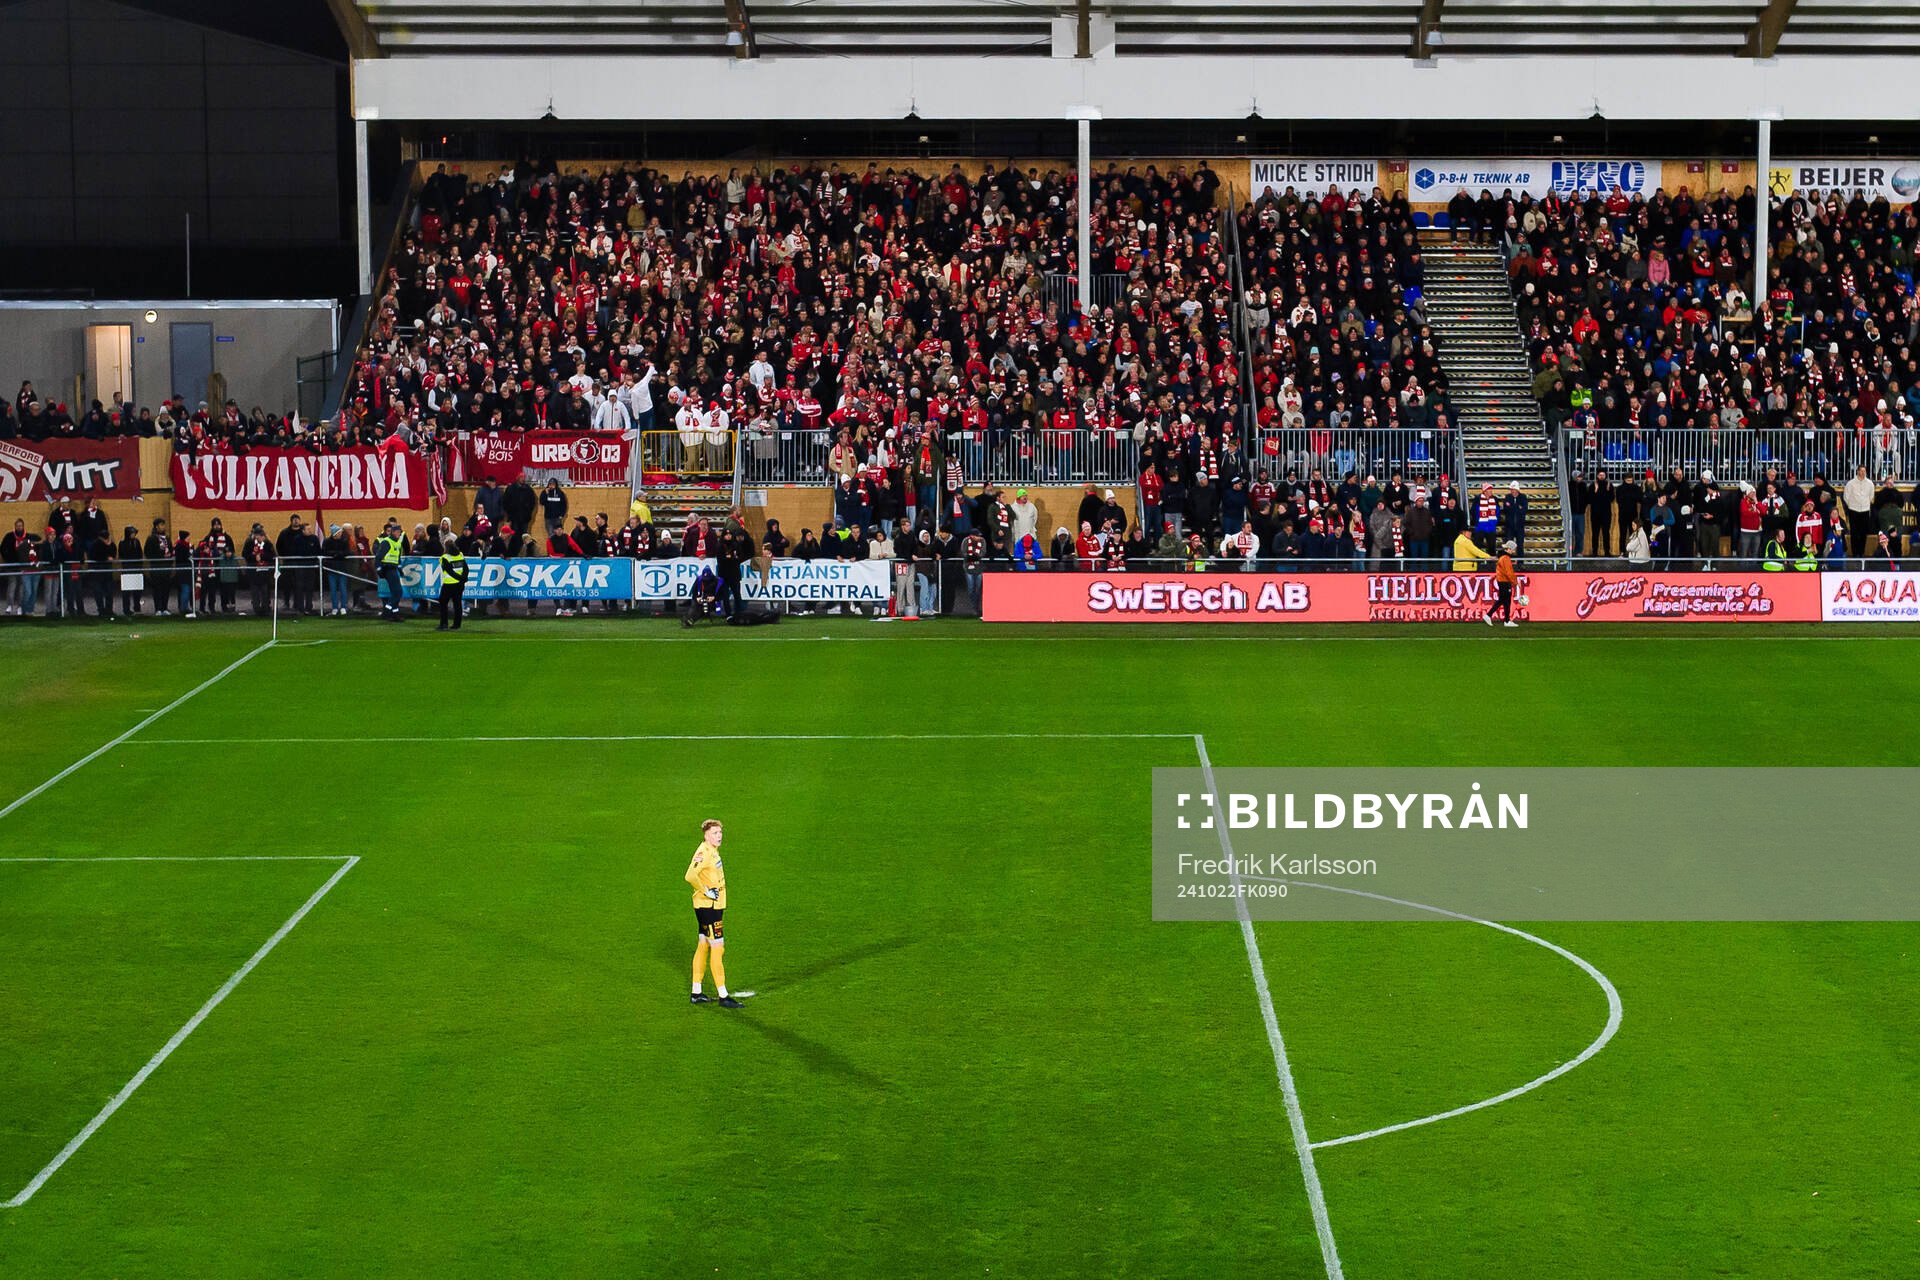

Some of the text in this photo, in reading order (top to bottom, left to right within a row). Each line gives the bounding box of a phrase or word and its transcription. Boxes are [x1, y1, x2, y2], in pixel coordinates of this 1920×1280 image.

[1255, 163, 1307, 182] MICKE
[1315, 163, 1374, 182] STRIDH
[1473, 173, 1512, 184] TEKNIK
[1515, 173, 1530, 184] AB
[1799, 167, 1884, 186] BEIJER
[0, 441, 40, 464] ERFORS
[489, 439, 521, 451] VALLA
[531, 444, 621, 463] URB 03
[41, 460, 121, 491] VITT
[588, 588, 600, 597] 35
[1257, 582, 1308, 612] AB
[1652, 583, 1762, 600] Presennings &
[1644, 598, 1772, 613] Kapell-Service AB
